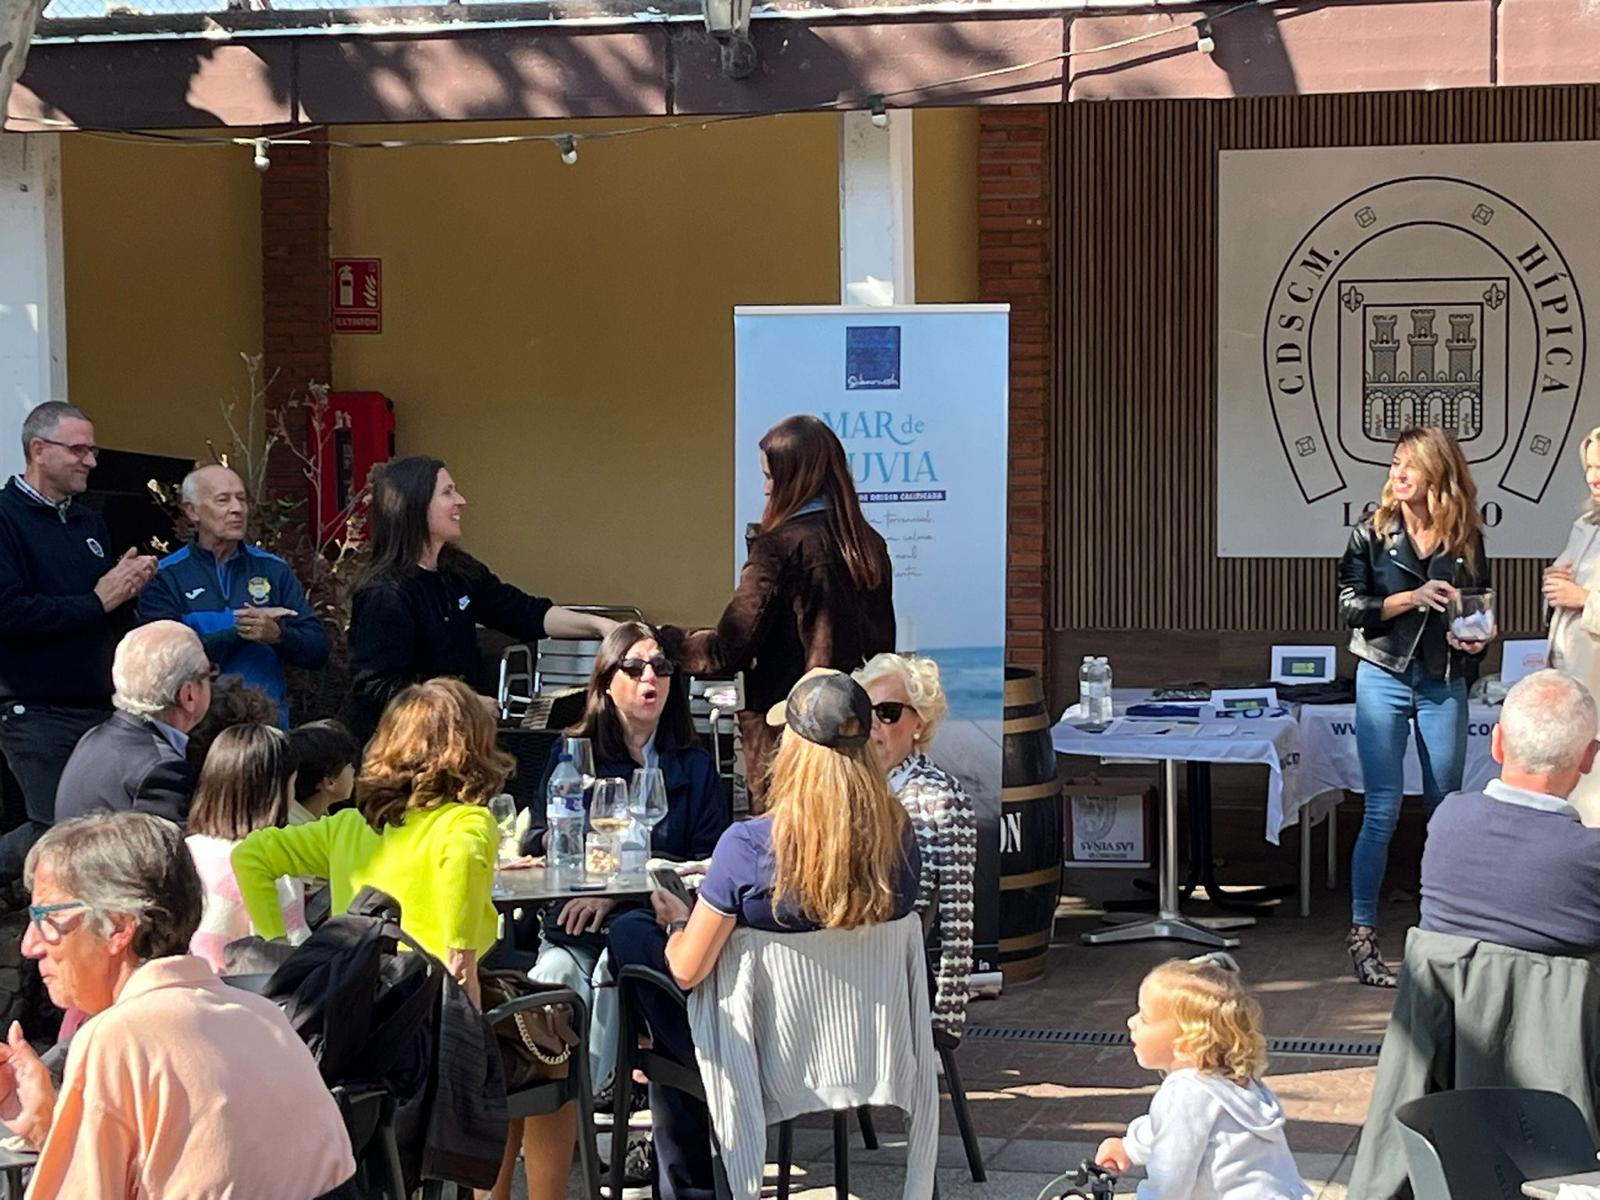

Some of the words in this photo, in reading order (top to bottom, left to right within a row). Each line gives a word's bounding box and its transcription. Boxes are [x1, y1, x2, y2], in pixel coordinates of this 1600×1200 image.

[1276, 247, 1340, 394] CDSCM.
[1516, 241, 1573, 393] HÍPICA
[822, 410, 914, 445] MAR
[901, 413, 926, 434] de
[847, 450, 940, 484] UVIA
